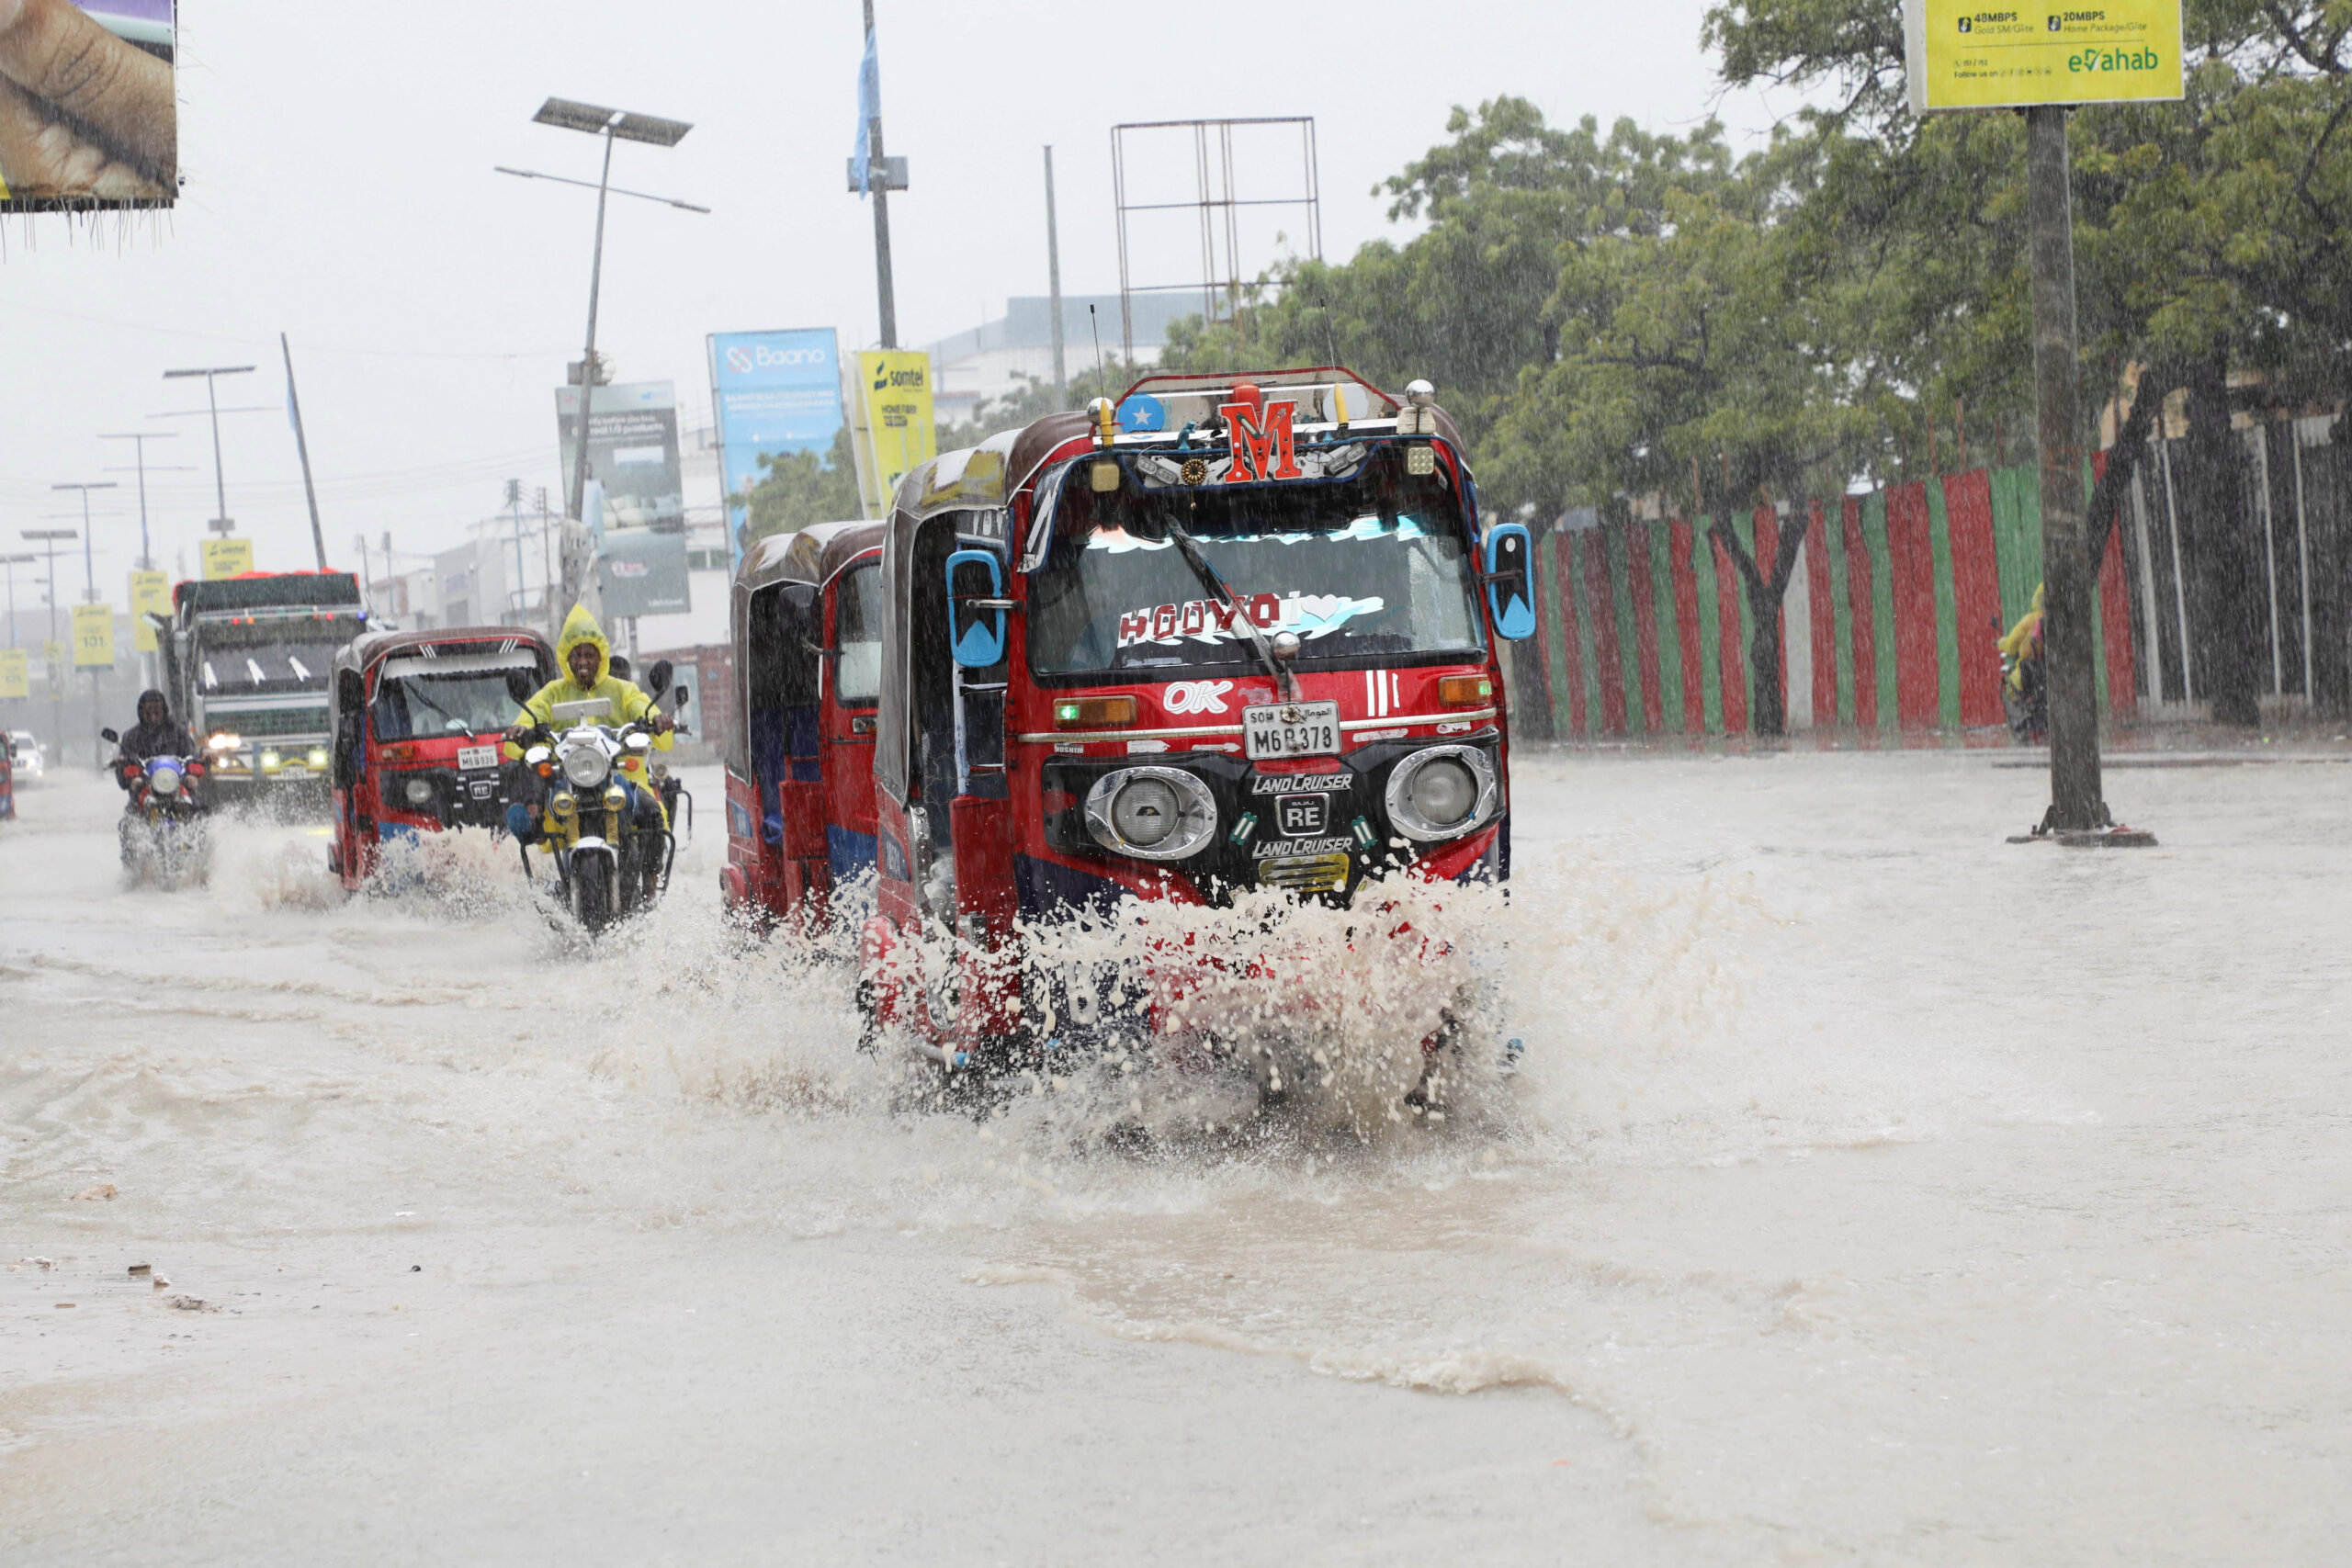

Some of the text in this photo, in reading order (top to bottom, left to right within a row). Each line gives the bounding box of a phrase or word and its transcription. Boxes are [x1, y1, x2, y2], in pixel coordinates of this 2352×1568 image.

[1973, 12, 2018, 23] 48MBPS
[2063, 11, 2105, 21] 20MBPS
[2064, 25, 2088, 33] Home
[756, 345, 826, 366] Baano
[889, 366, 923, 387] somtel
[1216, 399, 1303, 484] M
[1162, 680, 1234, 715] OK
[1286, 807, 1320, 827] RE
